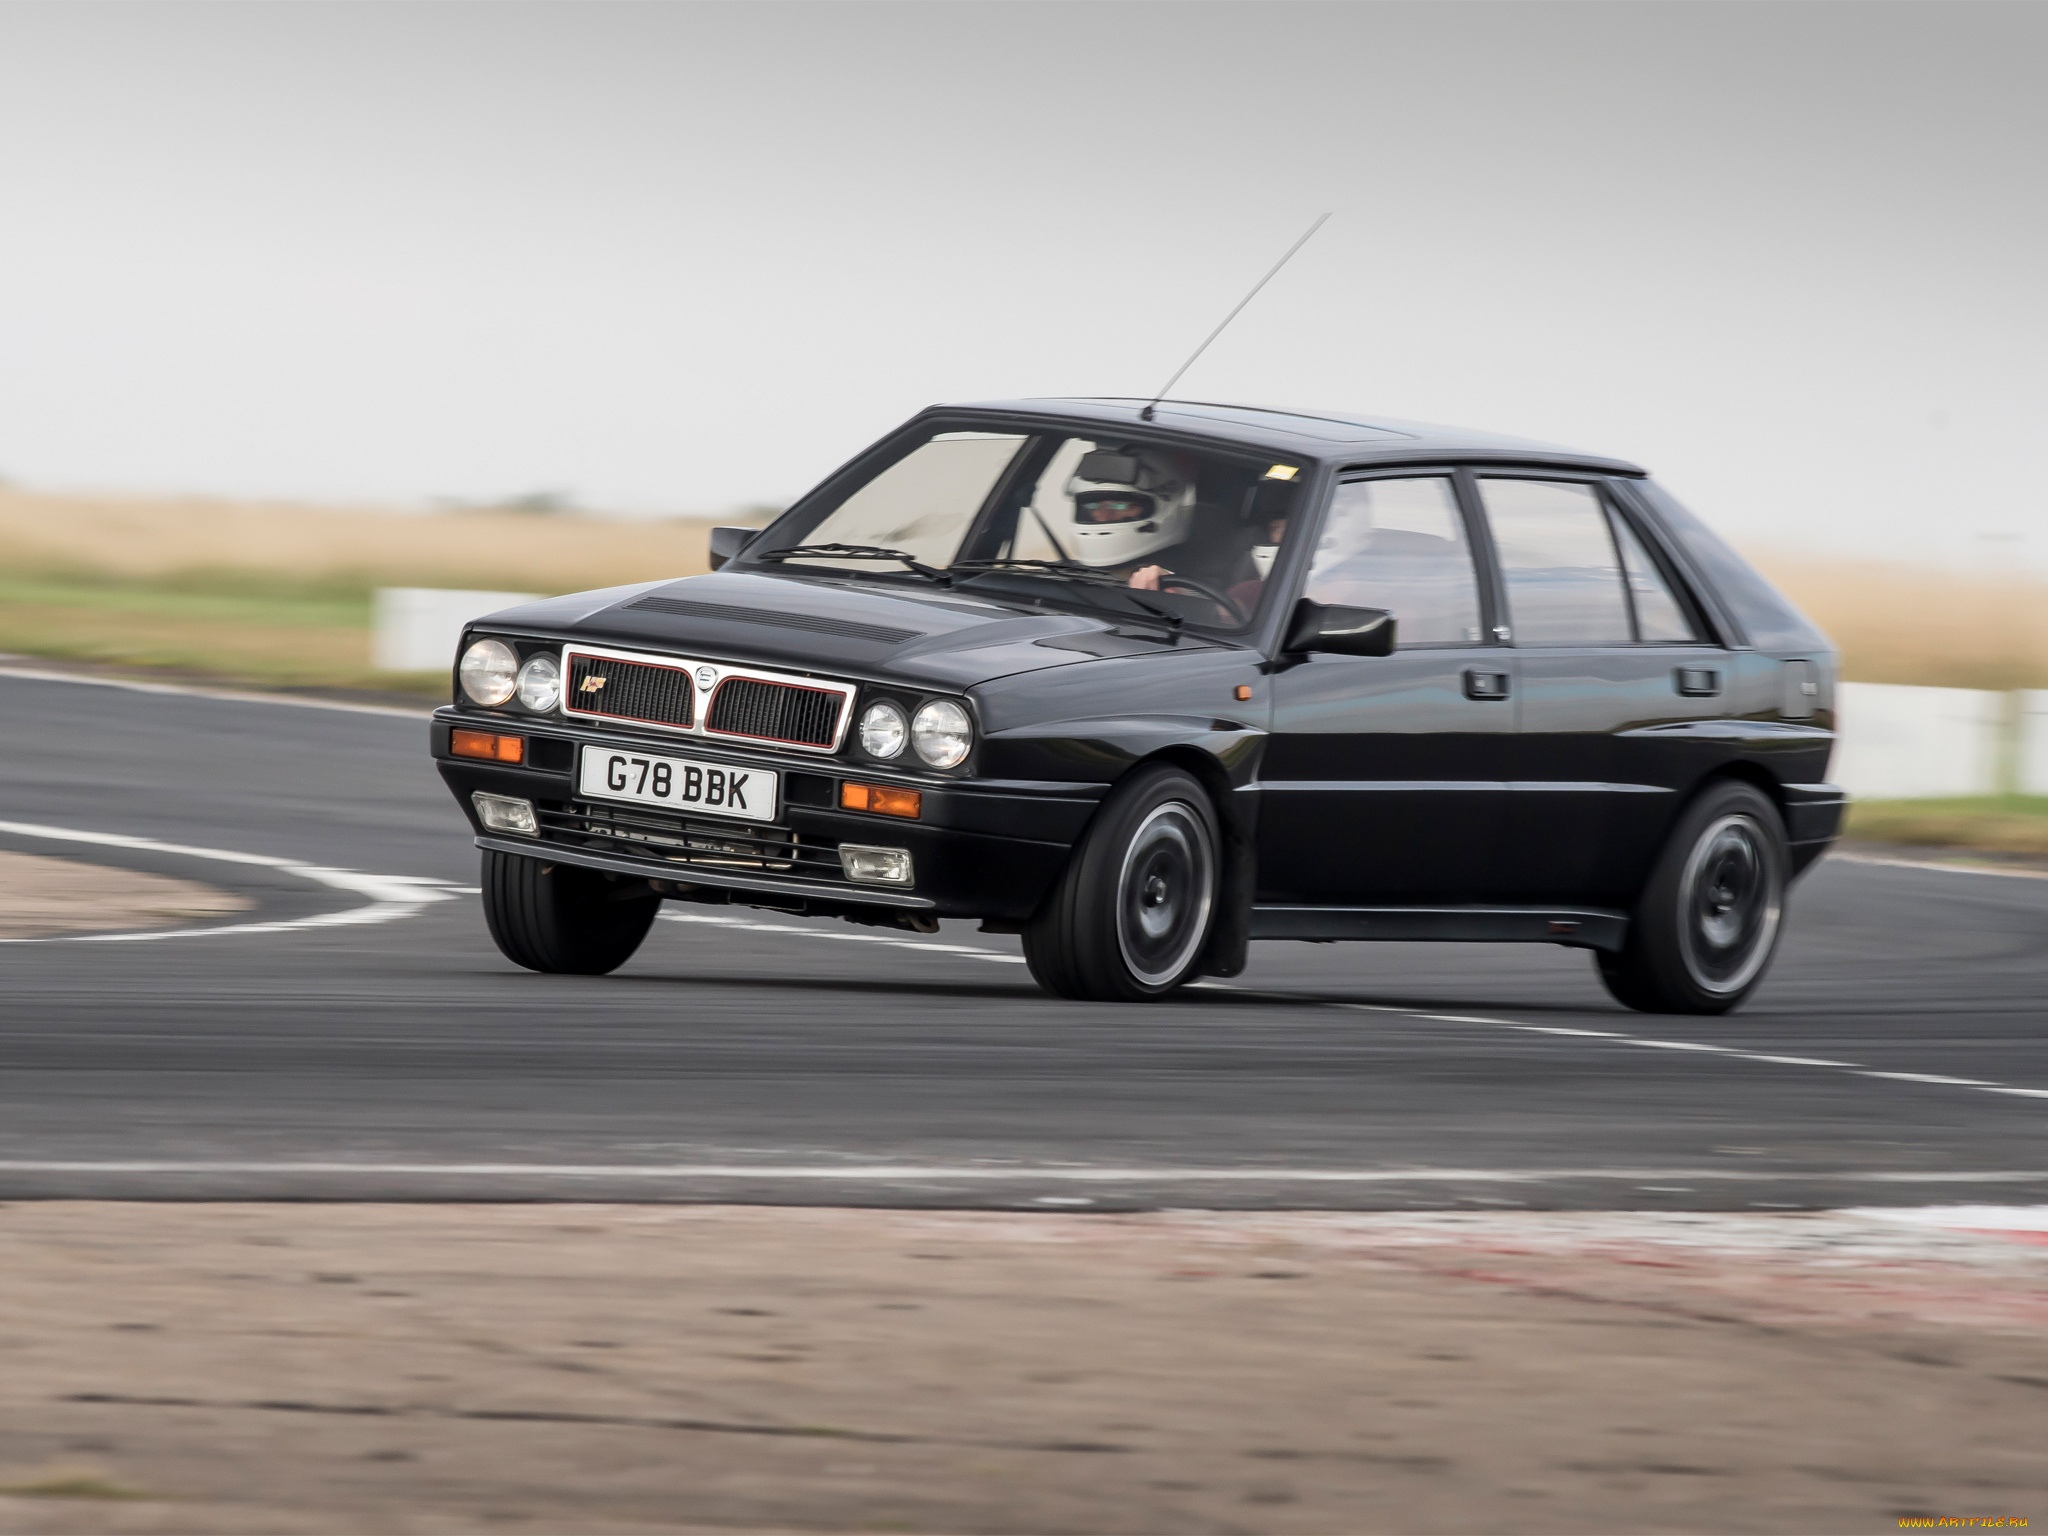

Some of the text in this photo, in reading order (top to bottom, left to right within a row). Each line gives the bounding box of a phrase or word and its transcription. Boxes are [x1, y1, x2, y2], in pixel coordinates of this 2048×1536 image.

[580, 675, 607, 693] HF
[607, 755, 749, 810] G78 BBK
